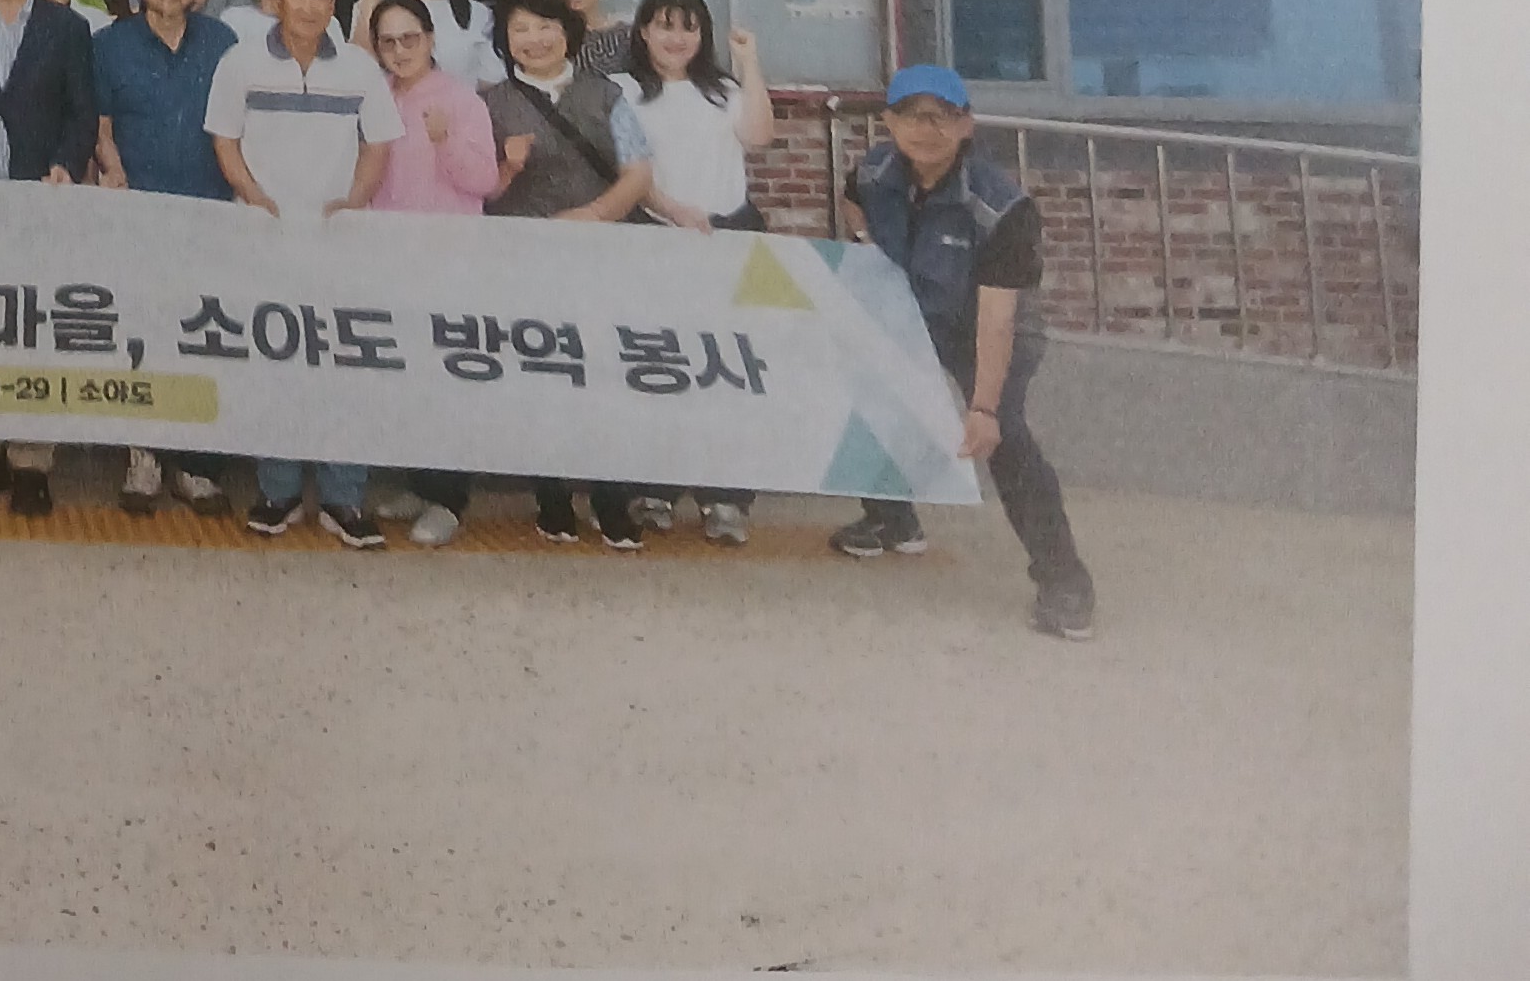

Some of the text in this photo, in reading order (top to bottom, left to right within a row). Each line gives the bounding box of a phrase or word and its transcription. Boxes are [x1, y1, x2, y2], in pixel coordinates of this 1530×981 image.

[177, 295, 406, 370] 소야도
[430, 313, 586, 387] 방역
[616, 325, 767, 394] 봉사
[79, 378, 154, 406] 소야도
